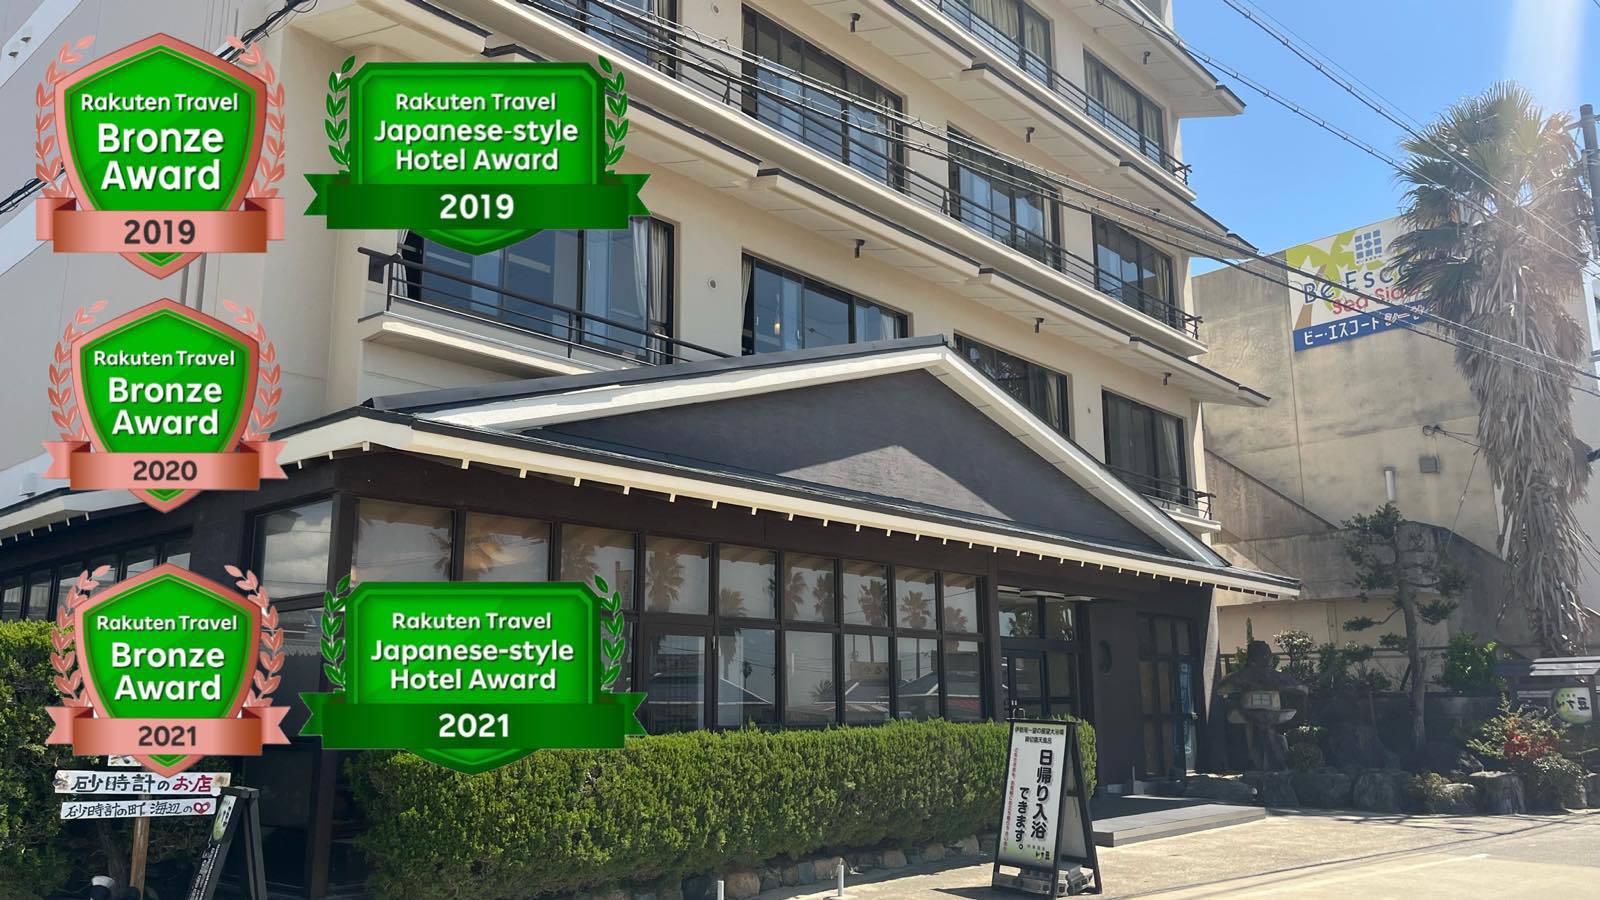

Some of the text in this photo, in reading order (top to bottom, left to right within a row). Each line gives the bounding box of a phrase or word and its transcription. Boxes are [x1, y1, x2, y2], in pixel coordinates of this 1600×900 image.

[70, 773, 213, 793] 砂時計のお店
[1031, 749, 1053, 839] 日帰り入浴
